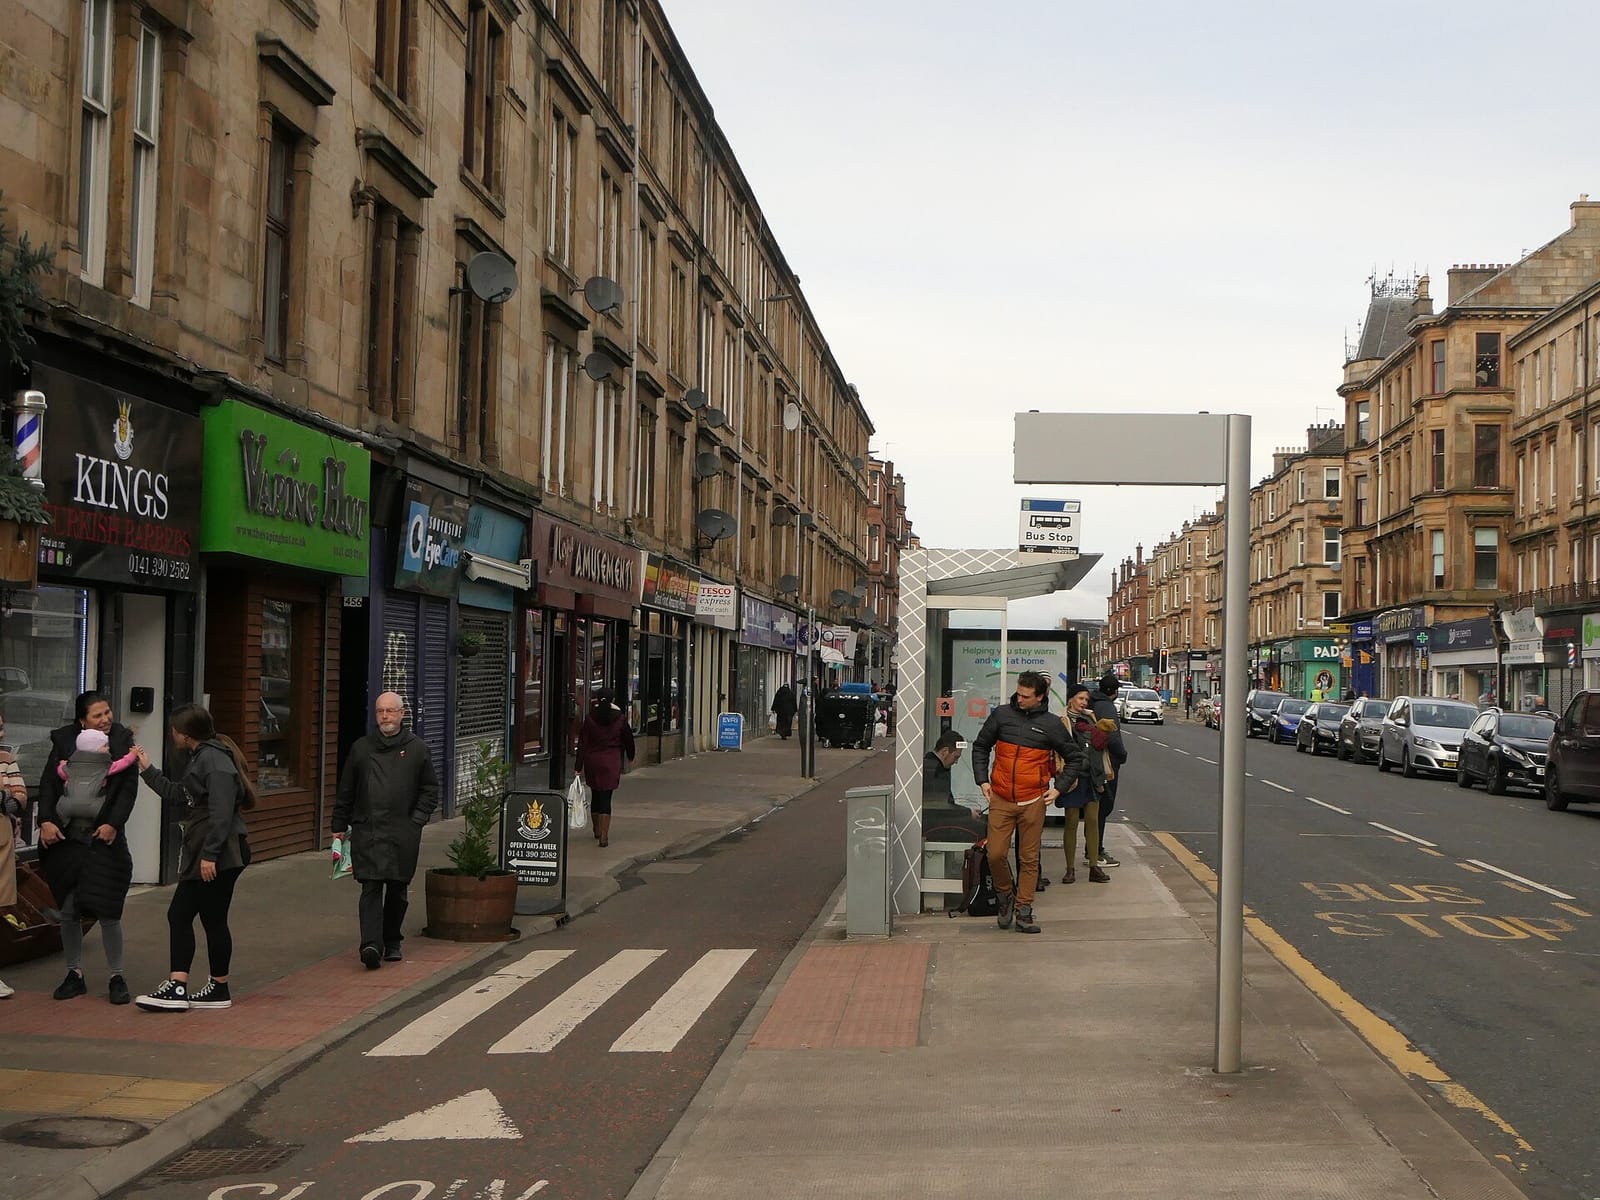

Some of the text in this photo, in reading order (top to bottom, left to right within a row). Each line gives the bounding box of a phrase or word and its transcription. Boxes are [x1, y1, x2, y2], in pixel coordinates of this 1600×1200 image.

[74, 453, 169, 520] KINGS
[124, 518, 192, 558] BARBERS
[428, 516, 463, 539] SOUTHSIDE
[1025, 531, 1073, 543] Bus Stop
[424, 534, 459, 571] EyeCare
[128, 553, 190, 580] 0141 390 2582
[574, 541, 634, 592] AMUSEMENTS
[700, 598, 731, 606] express
[701, 587, 731, 595] TESCO
[963, 646, 995, 655] Helping
[1014, 648, 1034, 656] stay
[974, 657, 991, 665] and
[1021, 657, 1045, 665] home
[510, 841, 523, 849] OPEN
[1299, 882, 1486, 905] BUS
[1312, 911, 1578, 942] STOP
